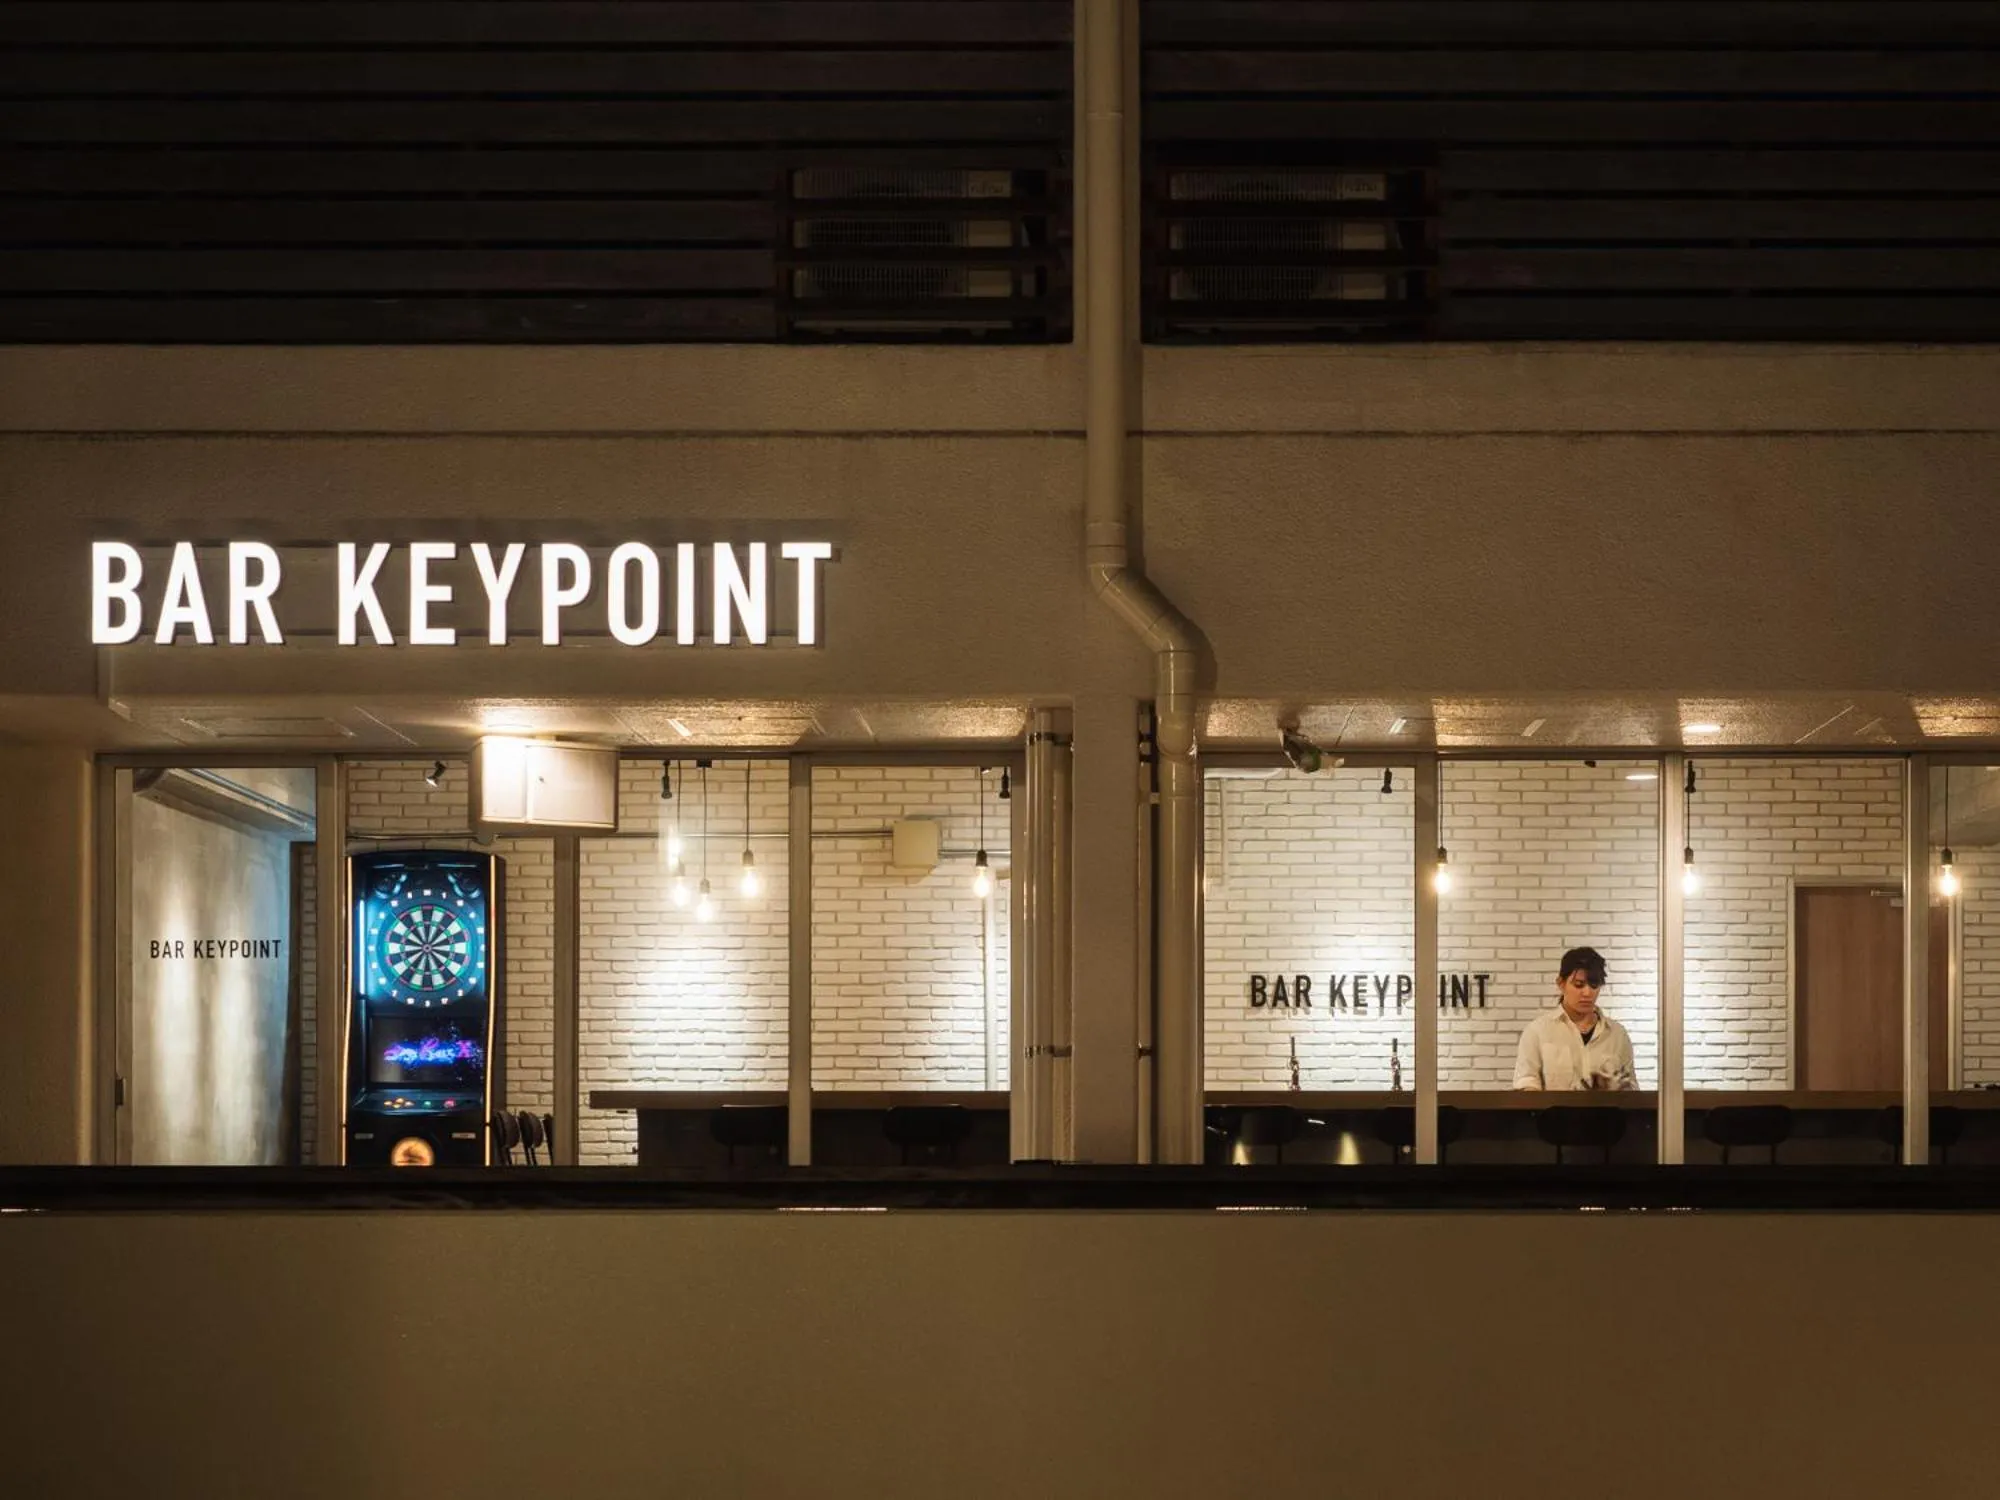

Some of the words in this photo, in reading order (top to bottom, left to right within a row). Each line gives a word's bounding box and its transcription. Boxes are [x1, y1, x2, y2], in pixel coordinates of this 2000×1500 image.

[92, 542, 283, 645] BAR
[338, 542, 832, 646] KEYPOINT
[150, 940, 185, 959] BAR
[193, 940, 282, 959] KEYPOINT
[1250, 974, 1313, 1008] BAR
[1329, 974, 1491, 1009] KEYPINT
